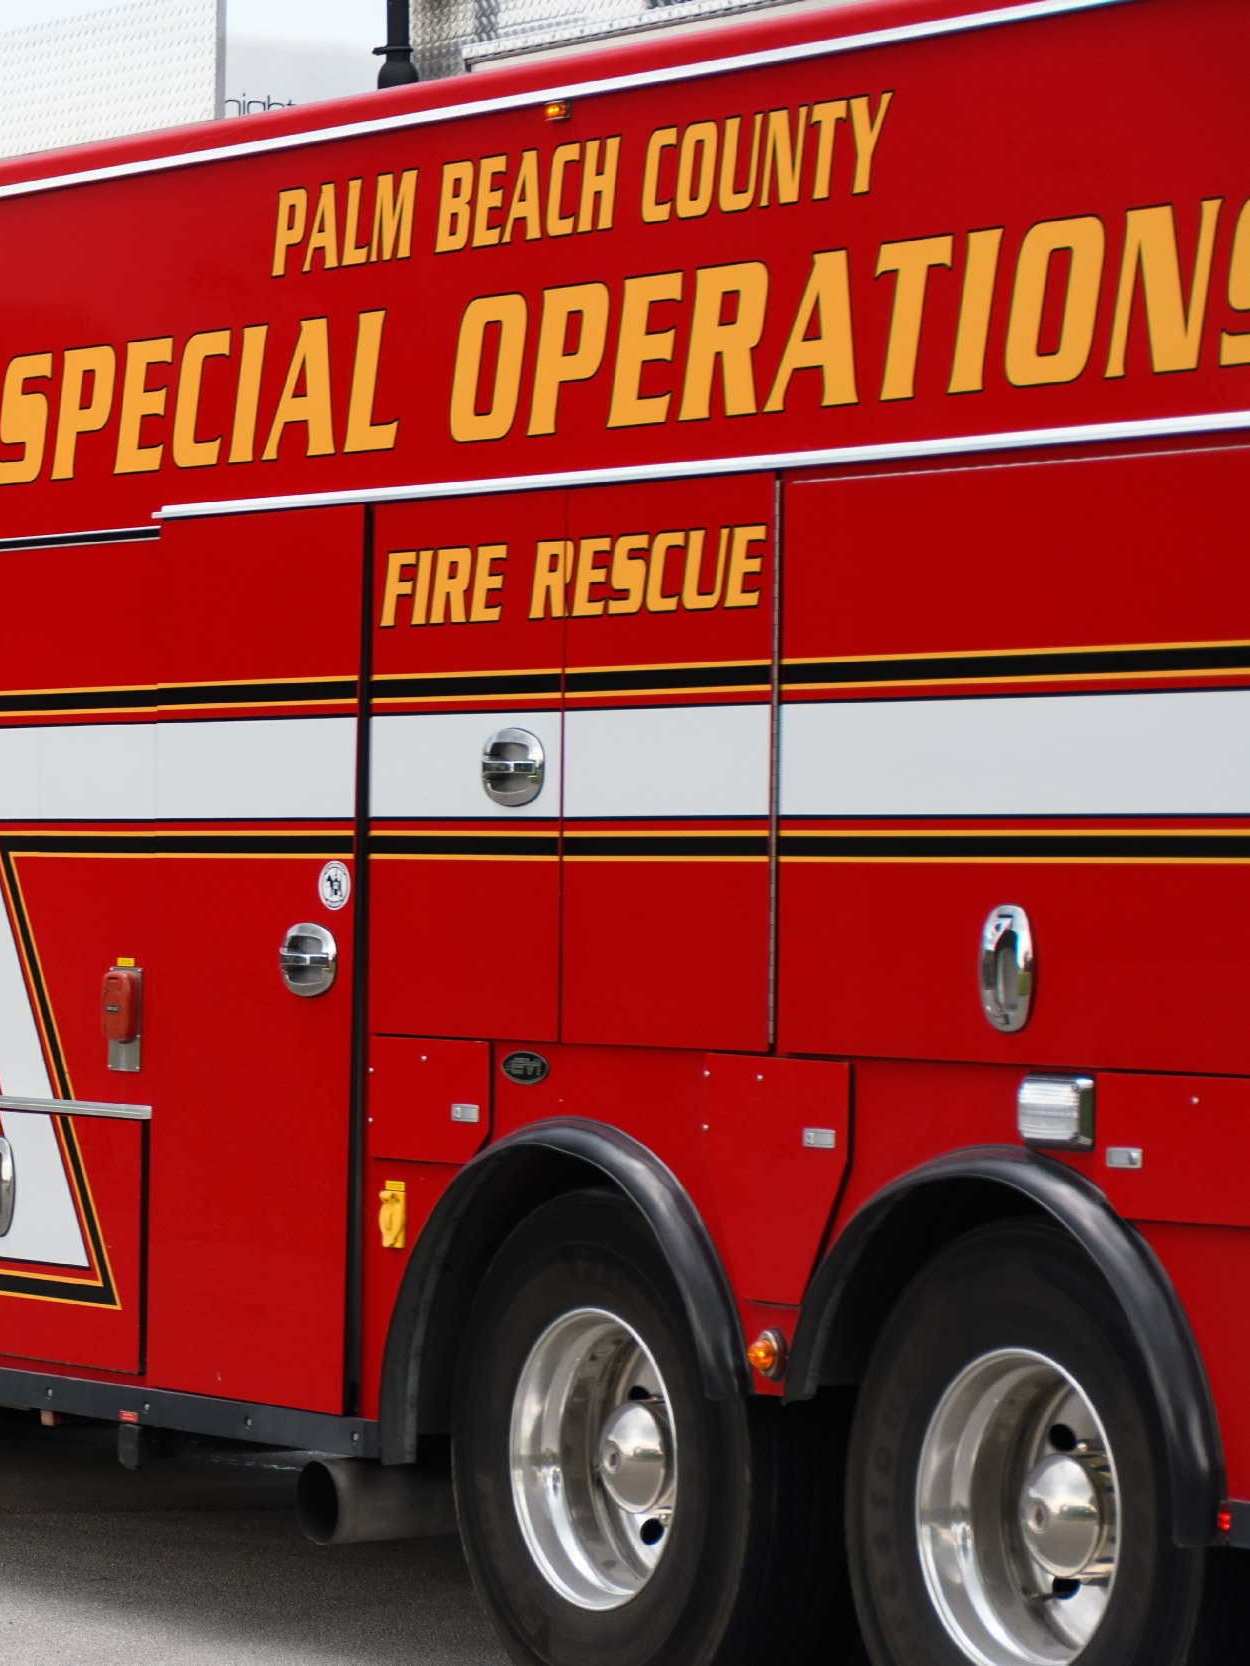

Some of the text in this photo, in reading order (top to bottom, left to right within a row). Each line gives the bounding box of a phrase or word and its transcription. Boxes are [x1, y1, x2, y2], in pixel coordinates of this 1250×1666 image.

[270, 91, 895, 278] PALM BEACH COUNTY
[379, 524, 768, 628] FIRE RESCUE
